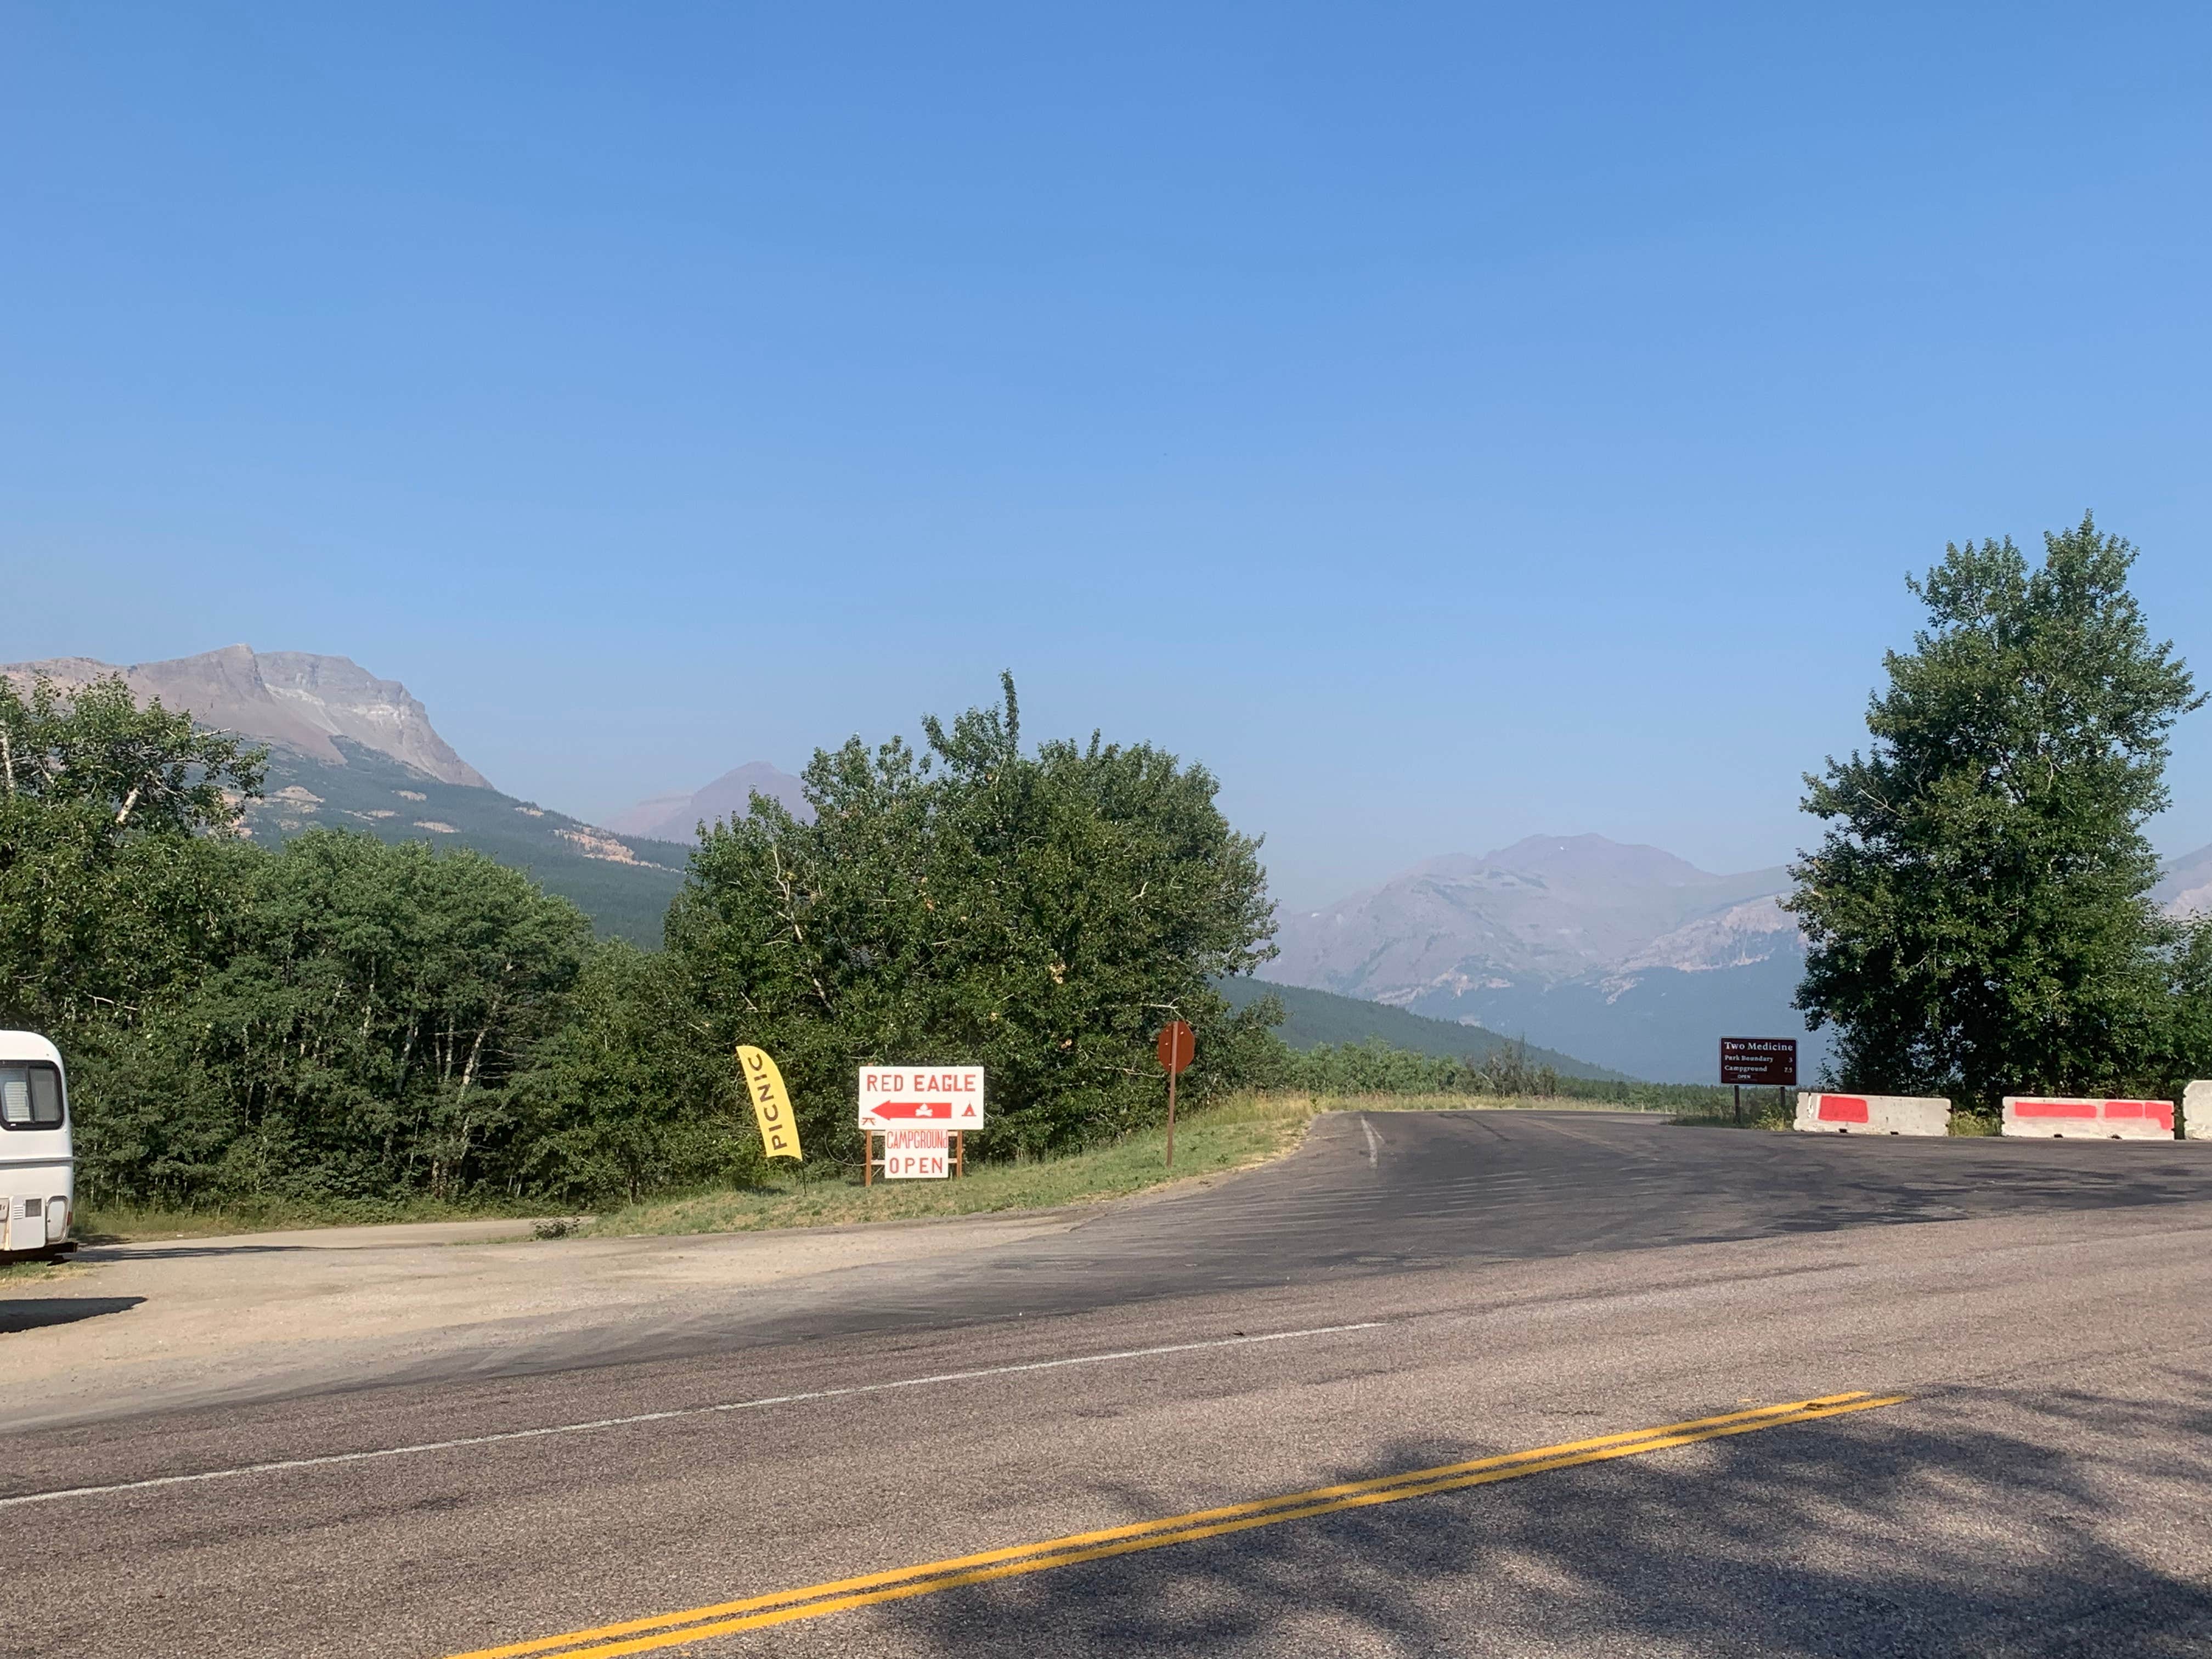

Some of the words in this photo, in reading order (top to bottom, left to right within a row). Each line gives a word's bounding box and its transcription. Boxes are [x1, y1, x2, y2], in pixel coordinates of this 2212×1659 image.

[1724, 1042, 1745, 1050] Two
[1748, 1042, 1793, 1051] Medicine
[867, 1075, 904, 1092] RED
[914, 1074, 976, 1092] EAGLE
[747, 1053, 787, 1150] PICNIC
[889, 1157, 943, 1173] OPEN
